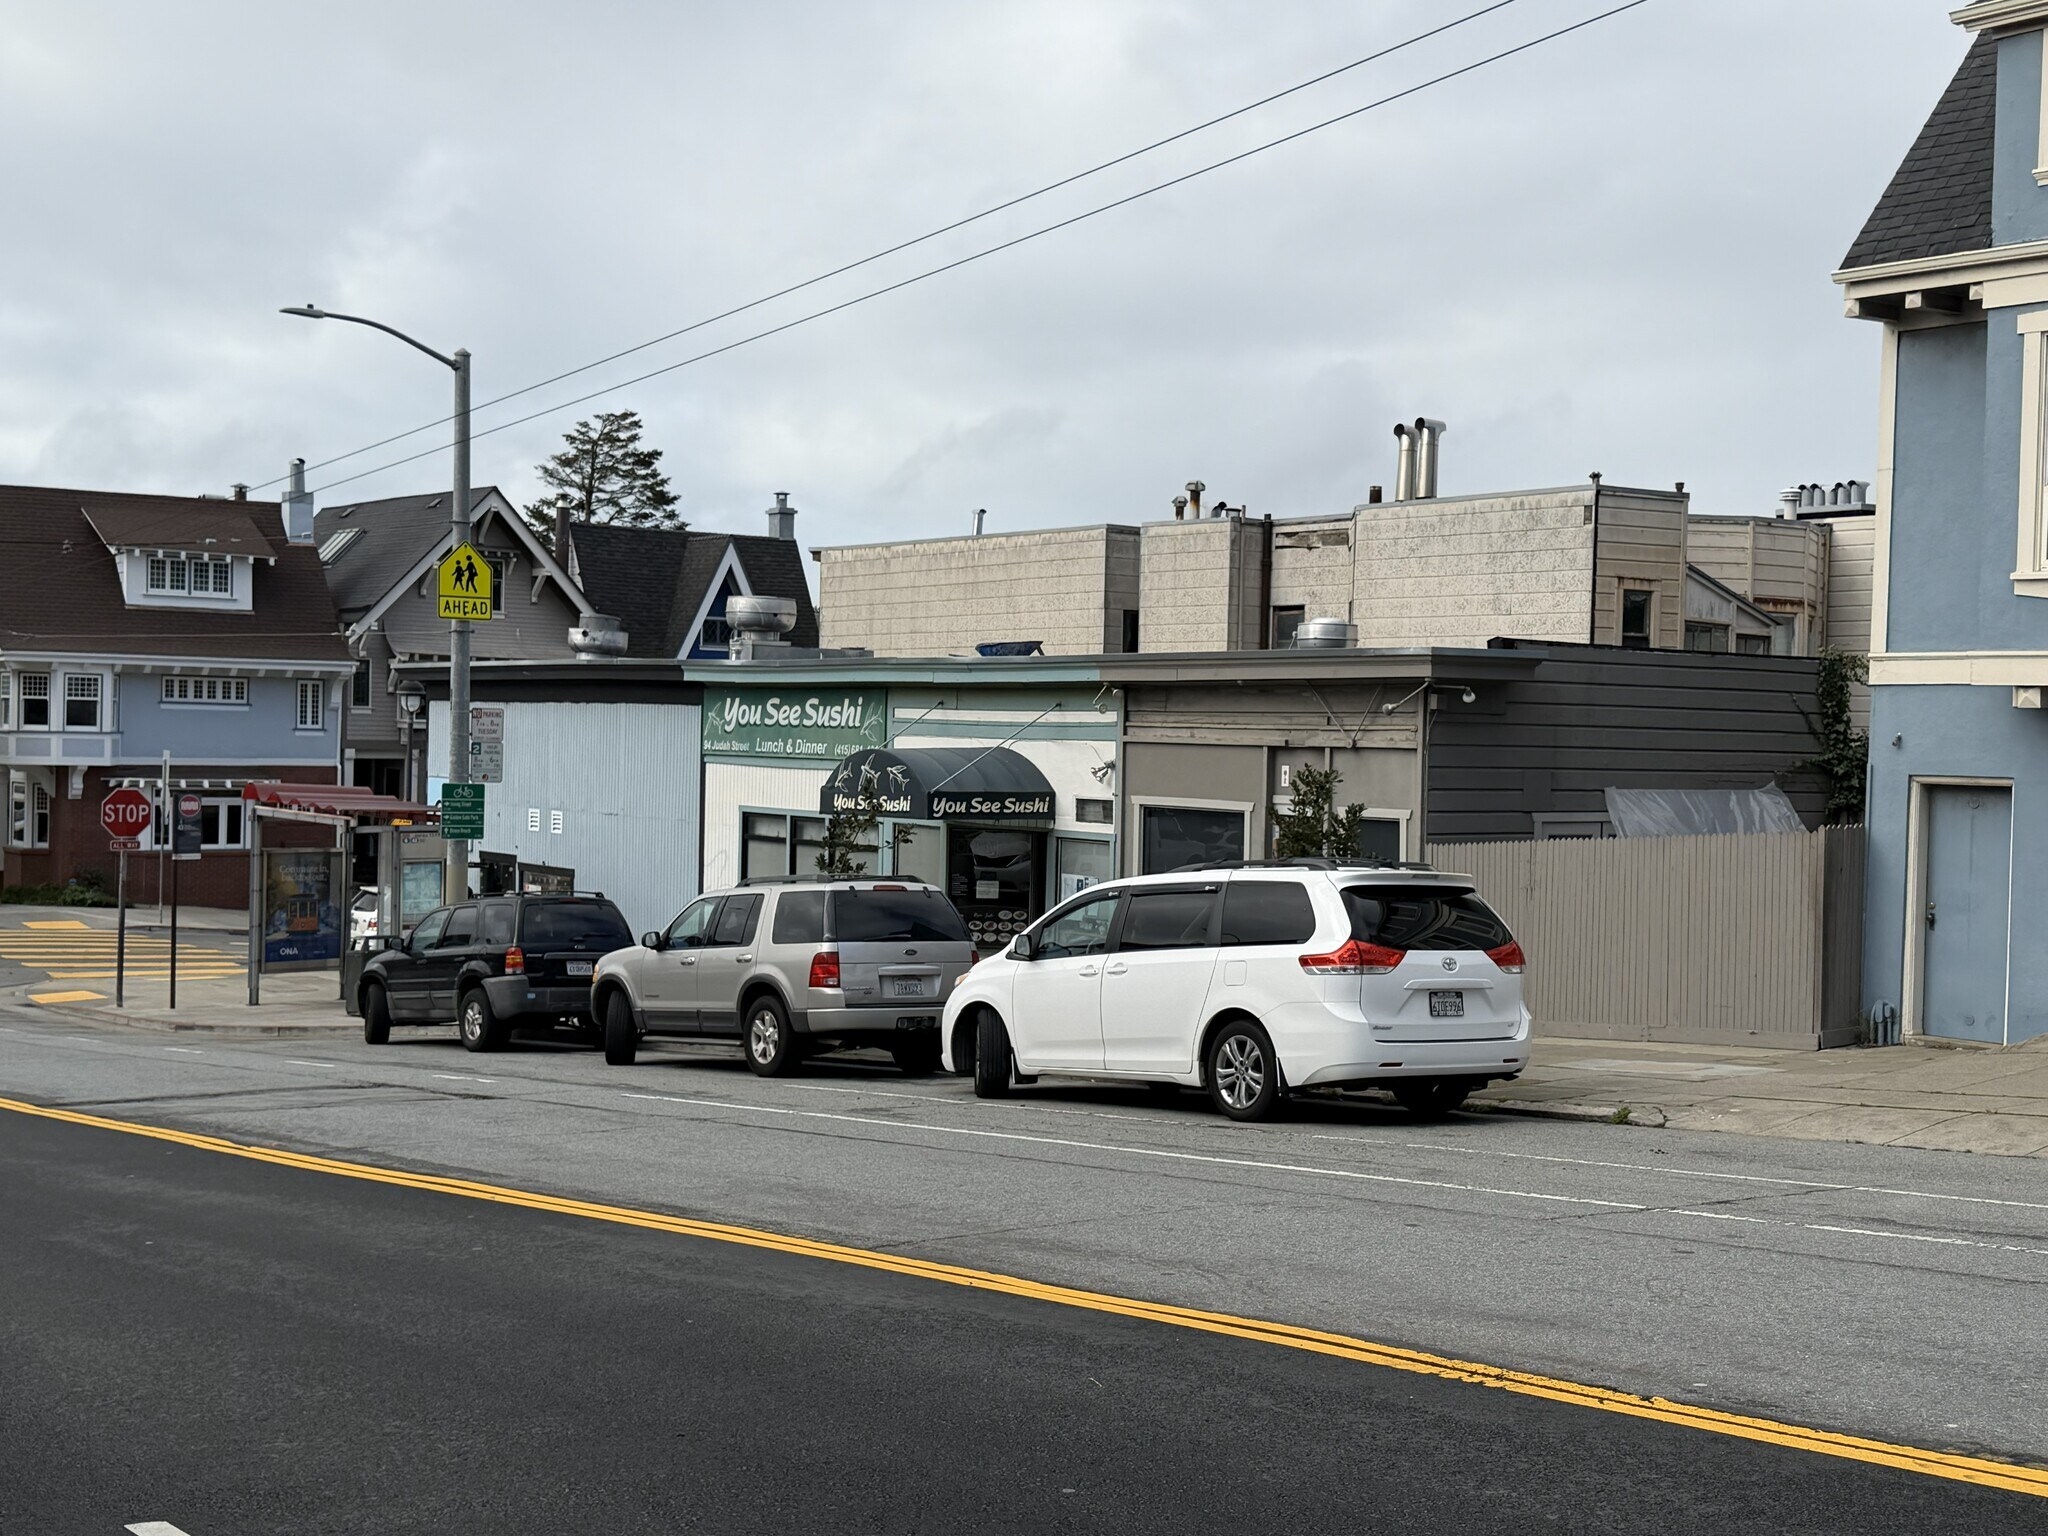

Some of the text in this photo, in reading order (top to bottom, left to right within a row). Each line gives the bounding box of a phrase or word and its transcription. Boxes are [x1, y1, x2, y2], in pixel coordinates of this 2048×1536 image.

[443, 599, 488, 616] AHEAD
[473, 709, 502, 718] NO PARKING
[724, 696, 863, 732] You See Sushi
[703, 739, 750, 751] 94 Judah Street
[755, 737, 828, 755] Lunch & Dinner
[833, 793, 856, 811] You
[879, 795, 911, 812] Sushi
[932, 796, 1049, 817] You See Sushi
[104, 804, 149, 823] STOP
[280, 947, 298, 956] ONA
